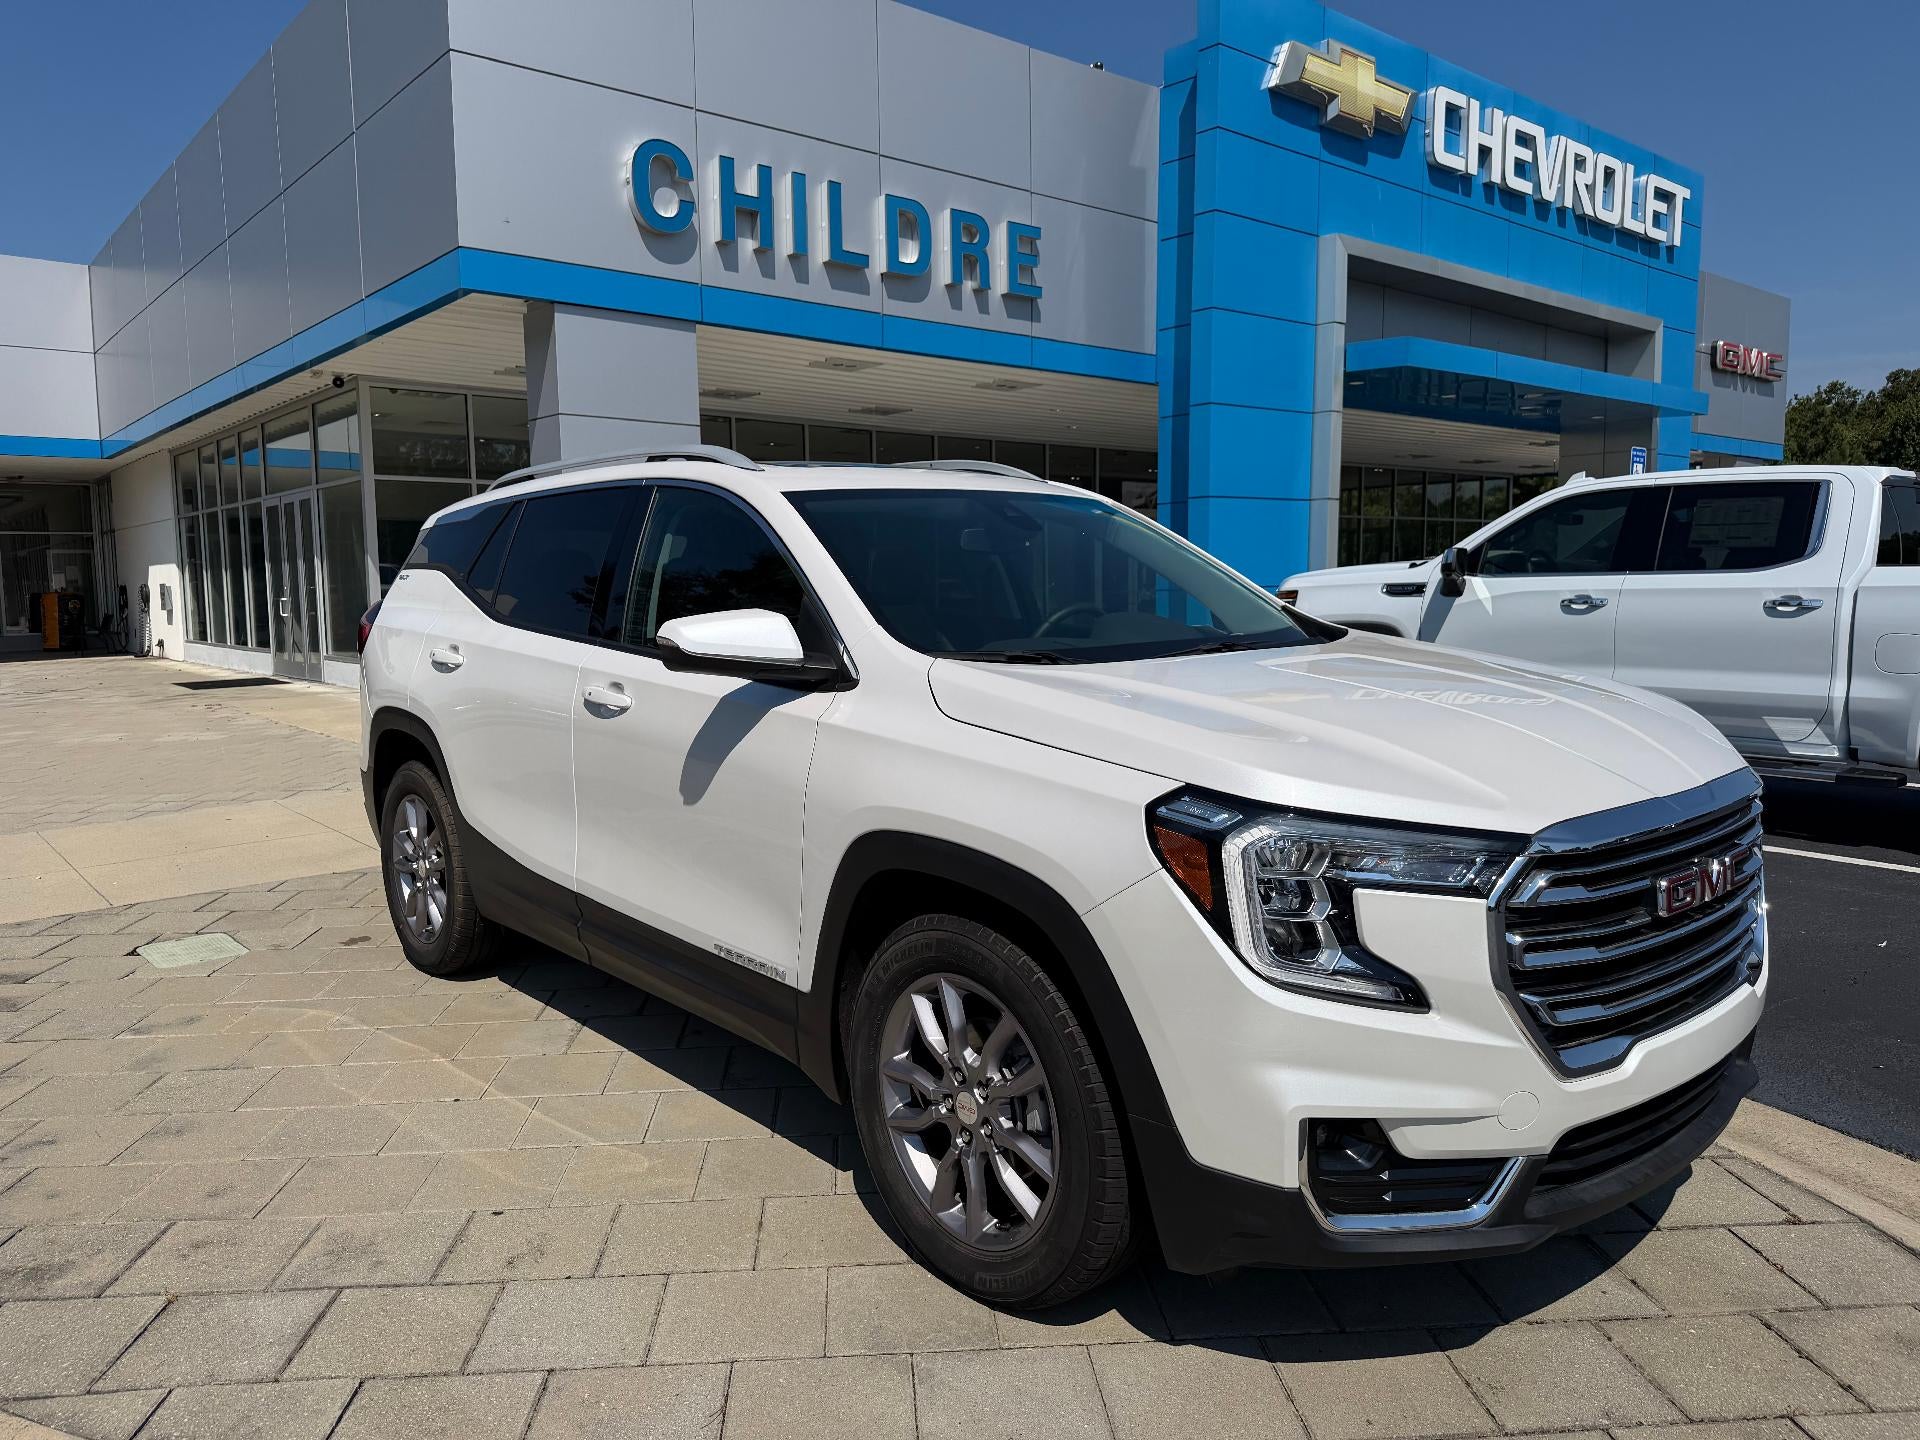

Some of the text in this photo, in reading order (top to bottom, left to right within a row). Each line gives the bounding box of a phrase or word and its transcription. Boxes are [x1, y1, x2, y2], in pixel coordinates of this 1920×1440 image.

[1428, 86, 1691, 247] CHEVROLET
[628, 138, 1043, 300] CHILDRE
[1715, 340, 1783, 382] GMC
[1657, 847, 1750, 917] GMC
[713, 943, 787, 982] TERRAIN
